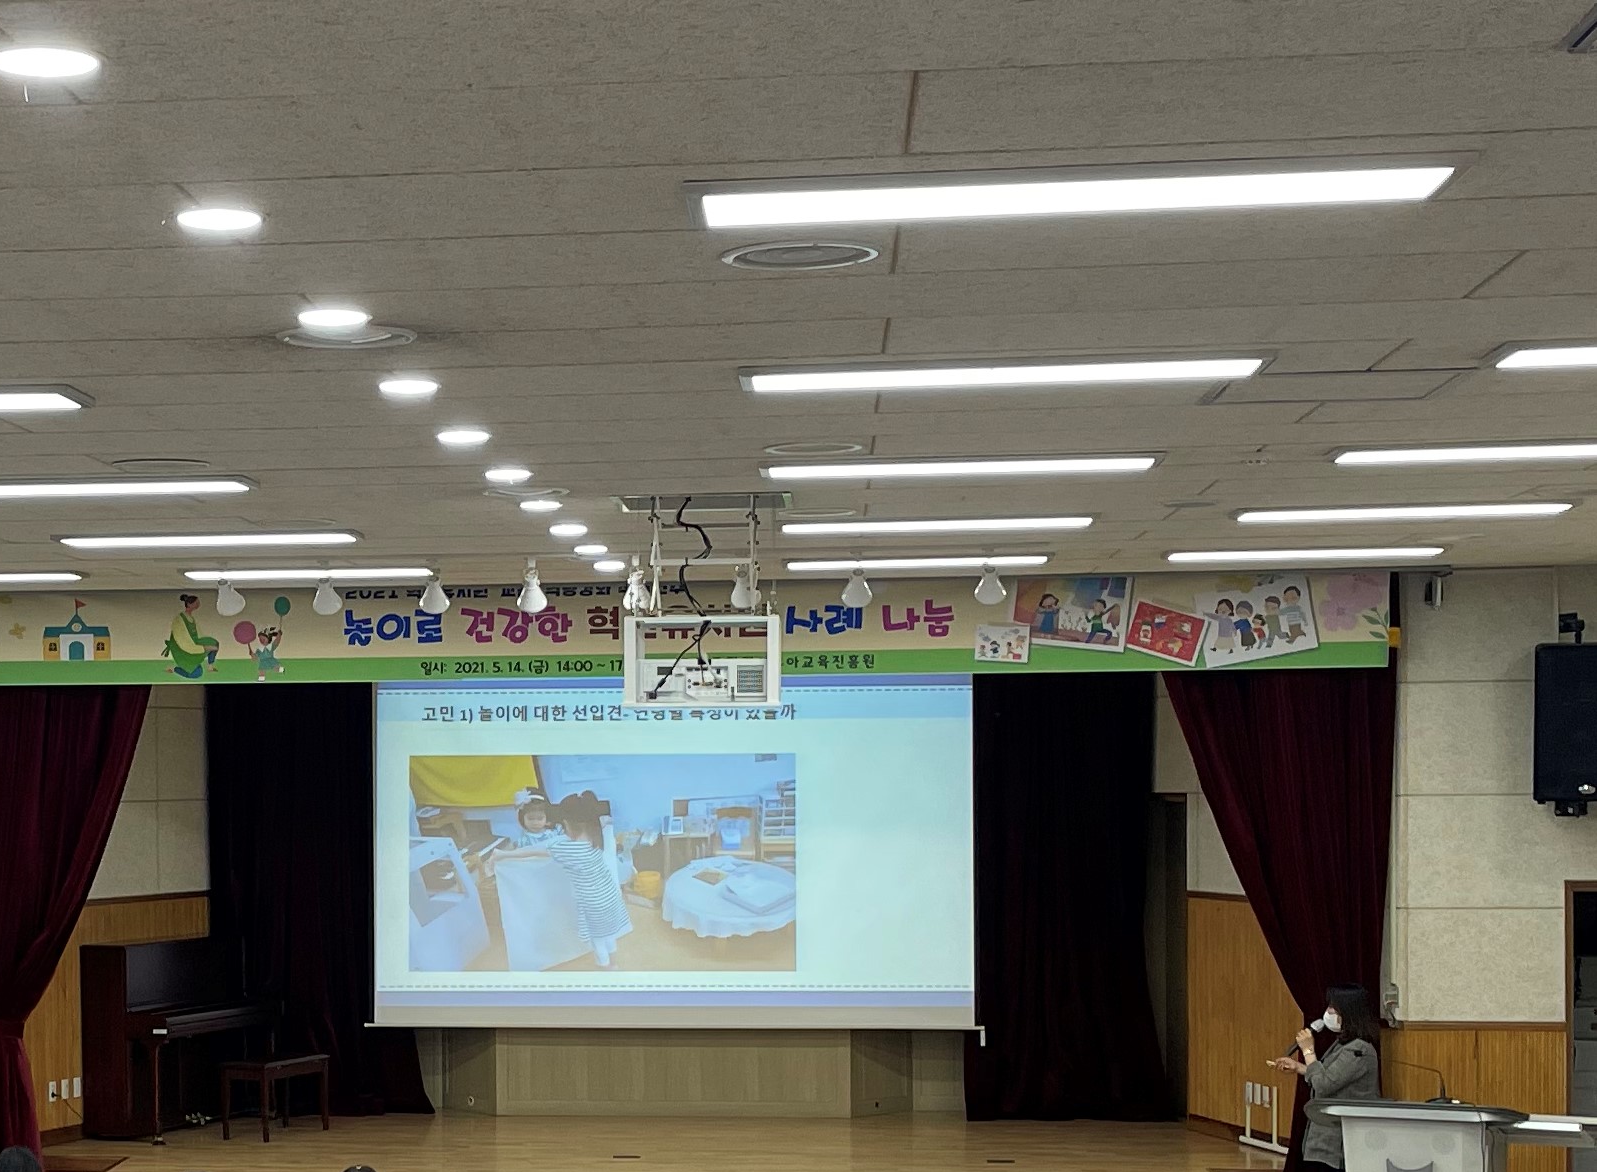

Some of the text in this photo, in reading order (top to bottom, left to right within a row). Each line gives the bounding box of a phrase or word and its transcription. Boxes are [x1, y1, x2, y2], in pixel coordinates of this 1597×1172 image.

[344, 609, 443, 646] 놀이로
[461, 605, 573, 643] 건강한
[786, 605, 862, 634] 사례
[882, 599, 954, 636] 나눔
[420, 661, 447, 675] 일시:
[454, 661, 489, 674] 2021.
[492, 661, 503, 674] 5.
[508, 661, 524, 673] 14.
[528, 660, 549, 674] (금)
[557, 660, 593, 673] 14:00
[421, 705, 454, 722] 고민
[460, 709, 473, 723] 1)
[478, 704, 528, 722] 놀이에
[534, 704, 567, 721] 대한
